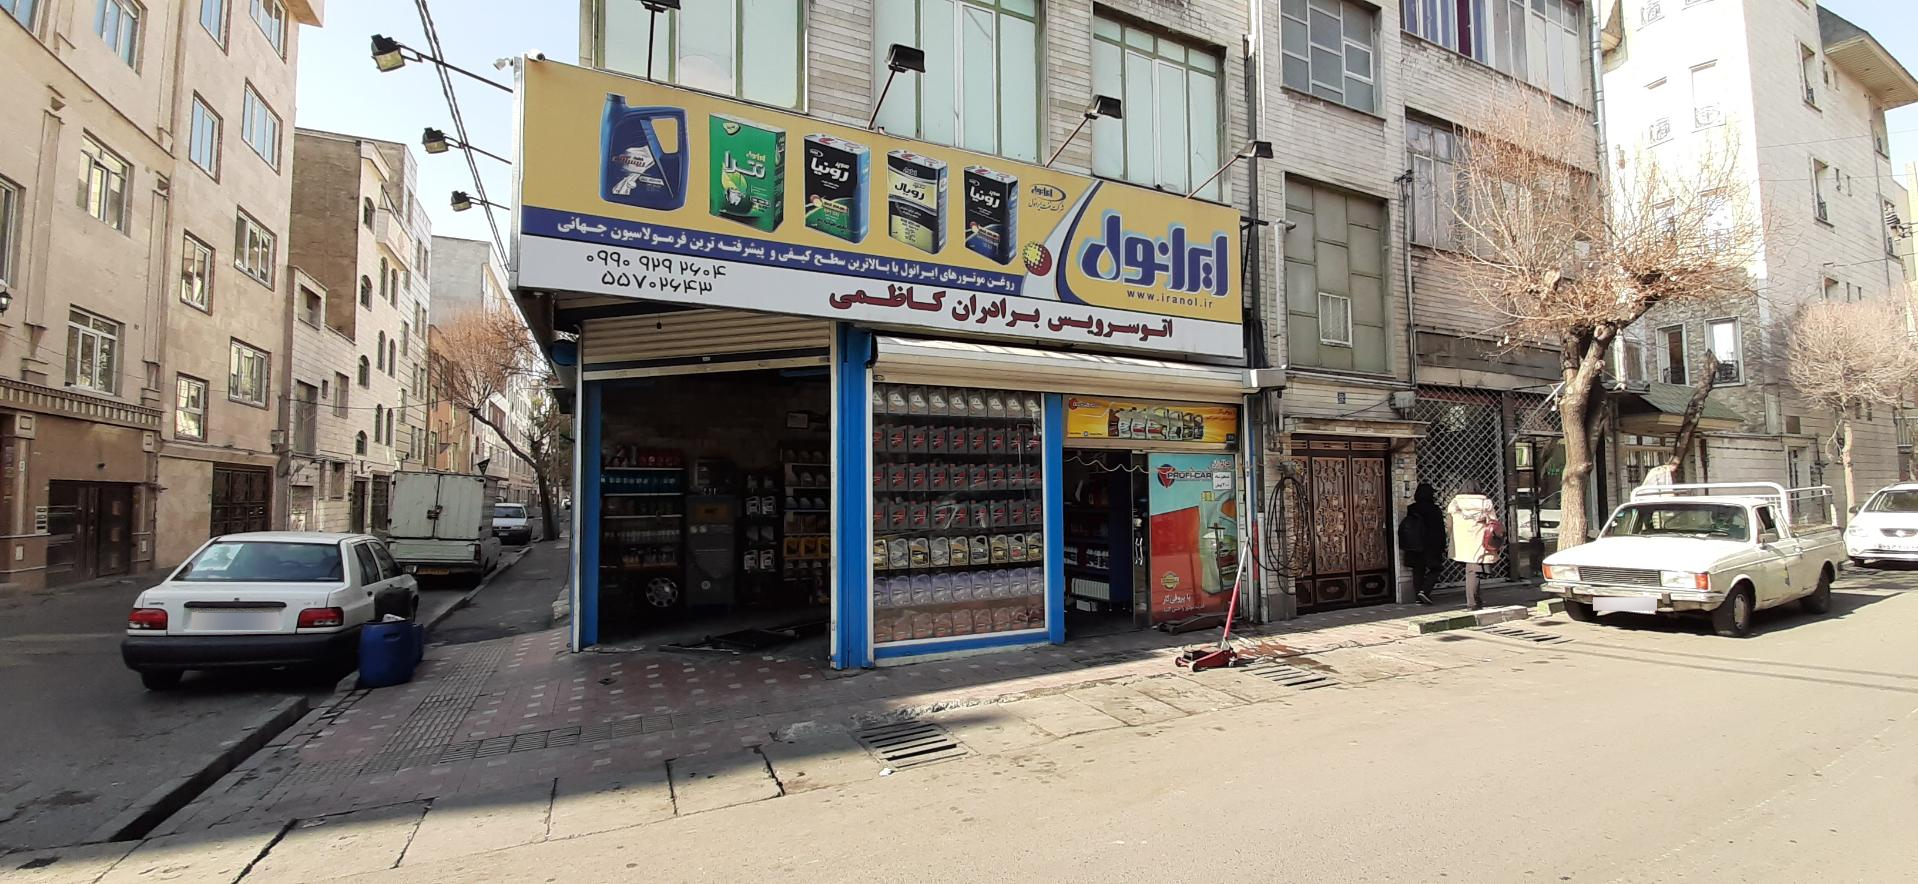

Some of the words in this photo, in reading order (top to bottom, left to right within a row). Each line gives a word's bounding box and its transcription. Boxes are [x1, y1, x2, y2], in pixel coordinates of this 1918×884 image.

[724, 150, 766, 178] تترا
[810, 157, 849, 182] رونیا
[894, 182, 925, 201] رویال
[969, 186, 1001, 208] رونیا
[557, 216, 608, 237] جهانی
[610, 226, 688, 248] فرمولاسیون
[689, 237, 715, 252] ترین
[717, 239, 765, 259] پیشرفته
[769, 249, 776, 261] و
[586, 250, 630, 268] ۰۹۹۰
[639, 255, 673, 274] ۹۲۹
[680, 260, 727, 279] ۲۶۰۴
[778, 247, 812, 264] کیفی
[813, 253, 846, 266] سطح
[1081, 213, 1229, 298] ایرانول
[847, 258, 890, 275] بالاترین
[891, 261, 899, 275] با
[900, 262, 938, 280] ایرانول
[601, 270, 713, 295] ۵۵۷۰۲۶۴۳
[987, 276, 1015, 291] روغن
[828, 283, 947, 313] کاظمی
[1126, 288, 1214, 309] www.iranol.ir
[951, 293, 1041, 329] برادران
[1047, 313, 1174, 342] اتوسرویس
